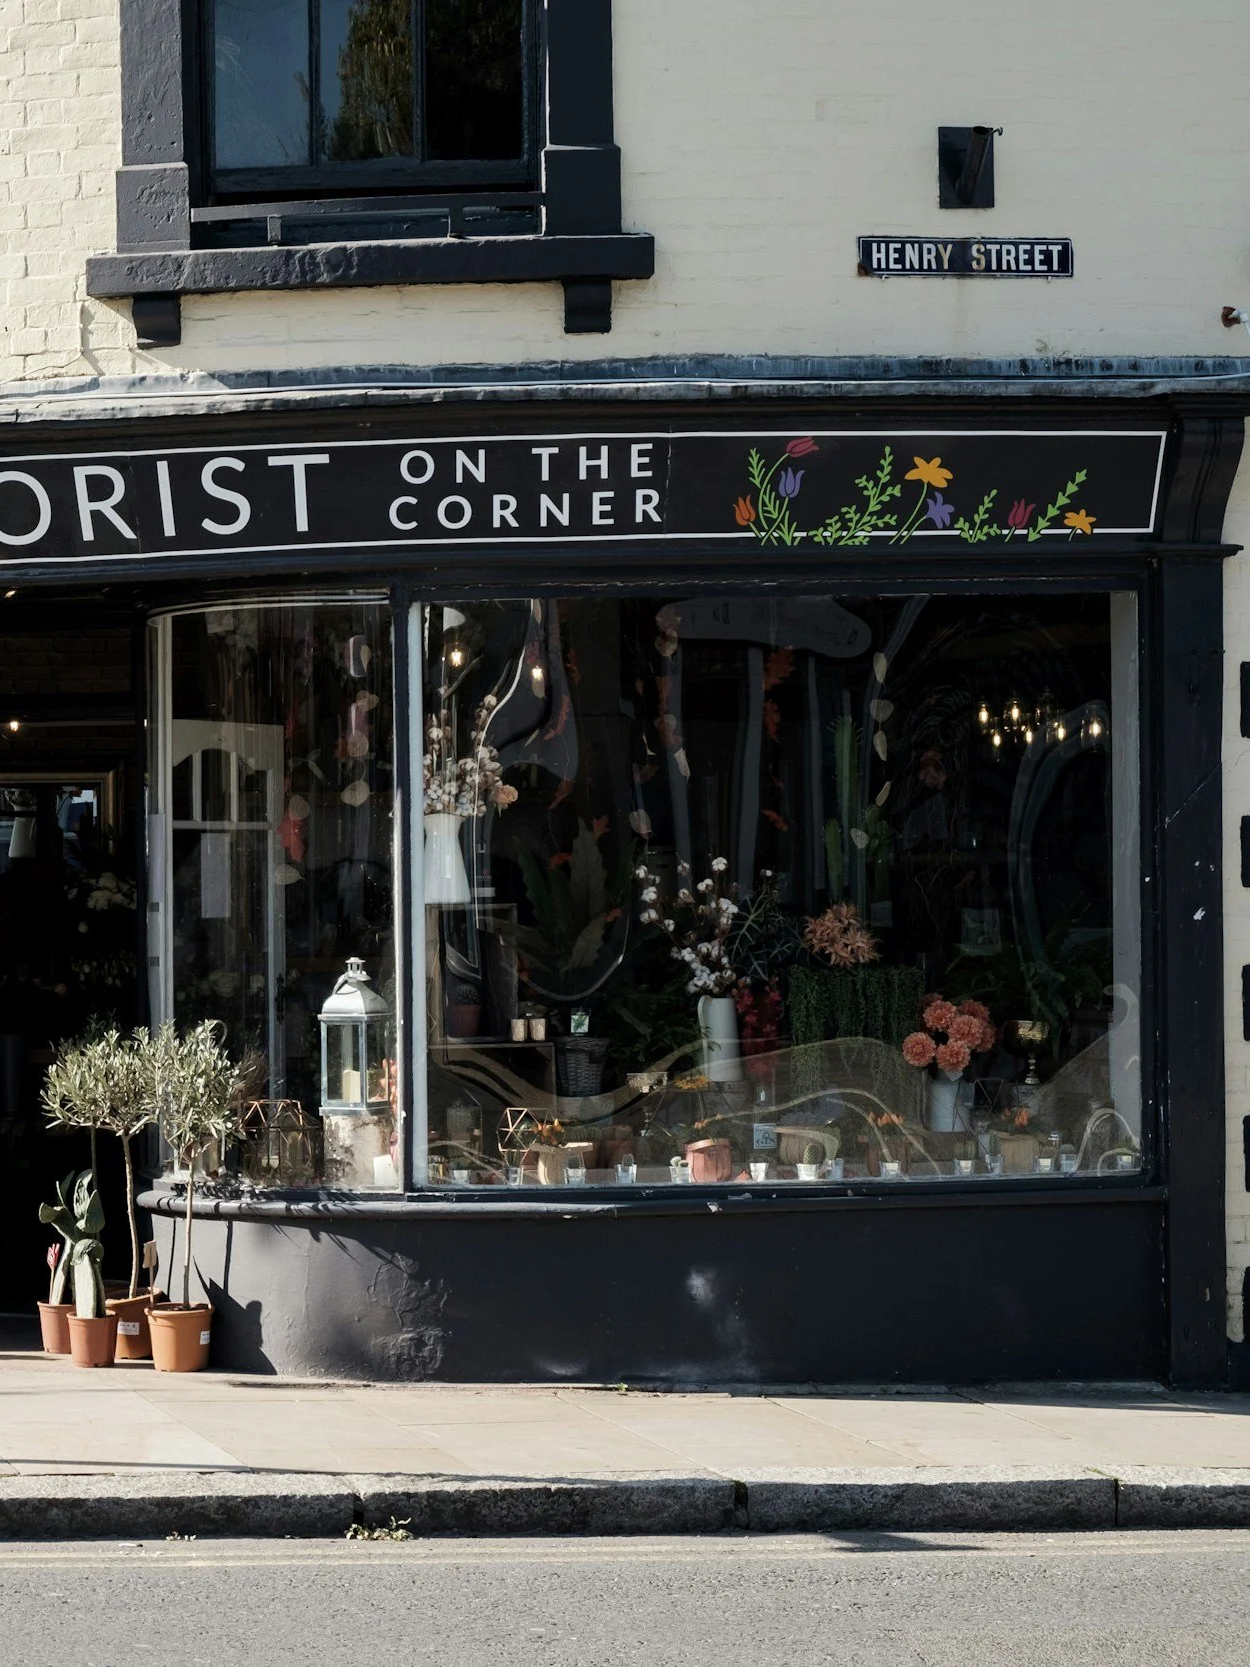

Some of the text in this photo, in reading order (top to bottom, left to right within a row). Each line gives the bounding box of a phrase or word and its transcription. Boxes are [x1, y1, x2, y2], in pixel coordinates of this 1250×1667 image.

[871, 242, 1063, 271] HENRY STREET
[398, 442, 654, 485] ON THE
[388, 487, 662, 531] CORNER
